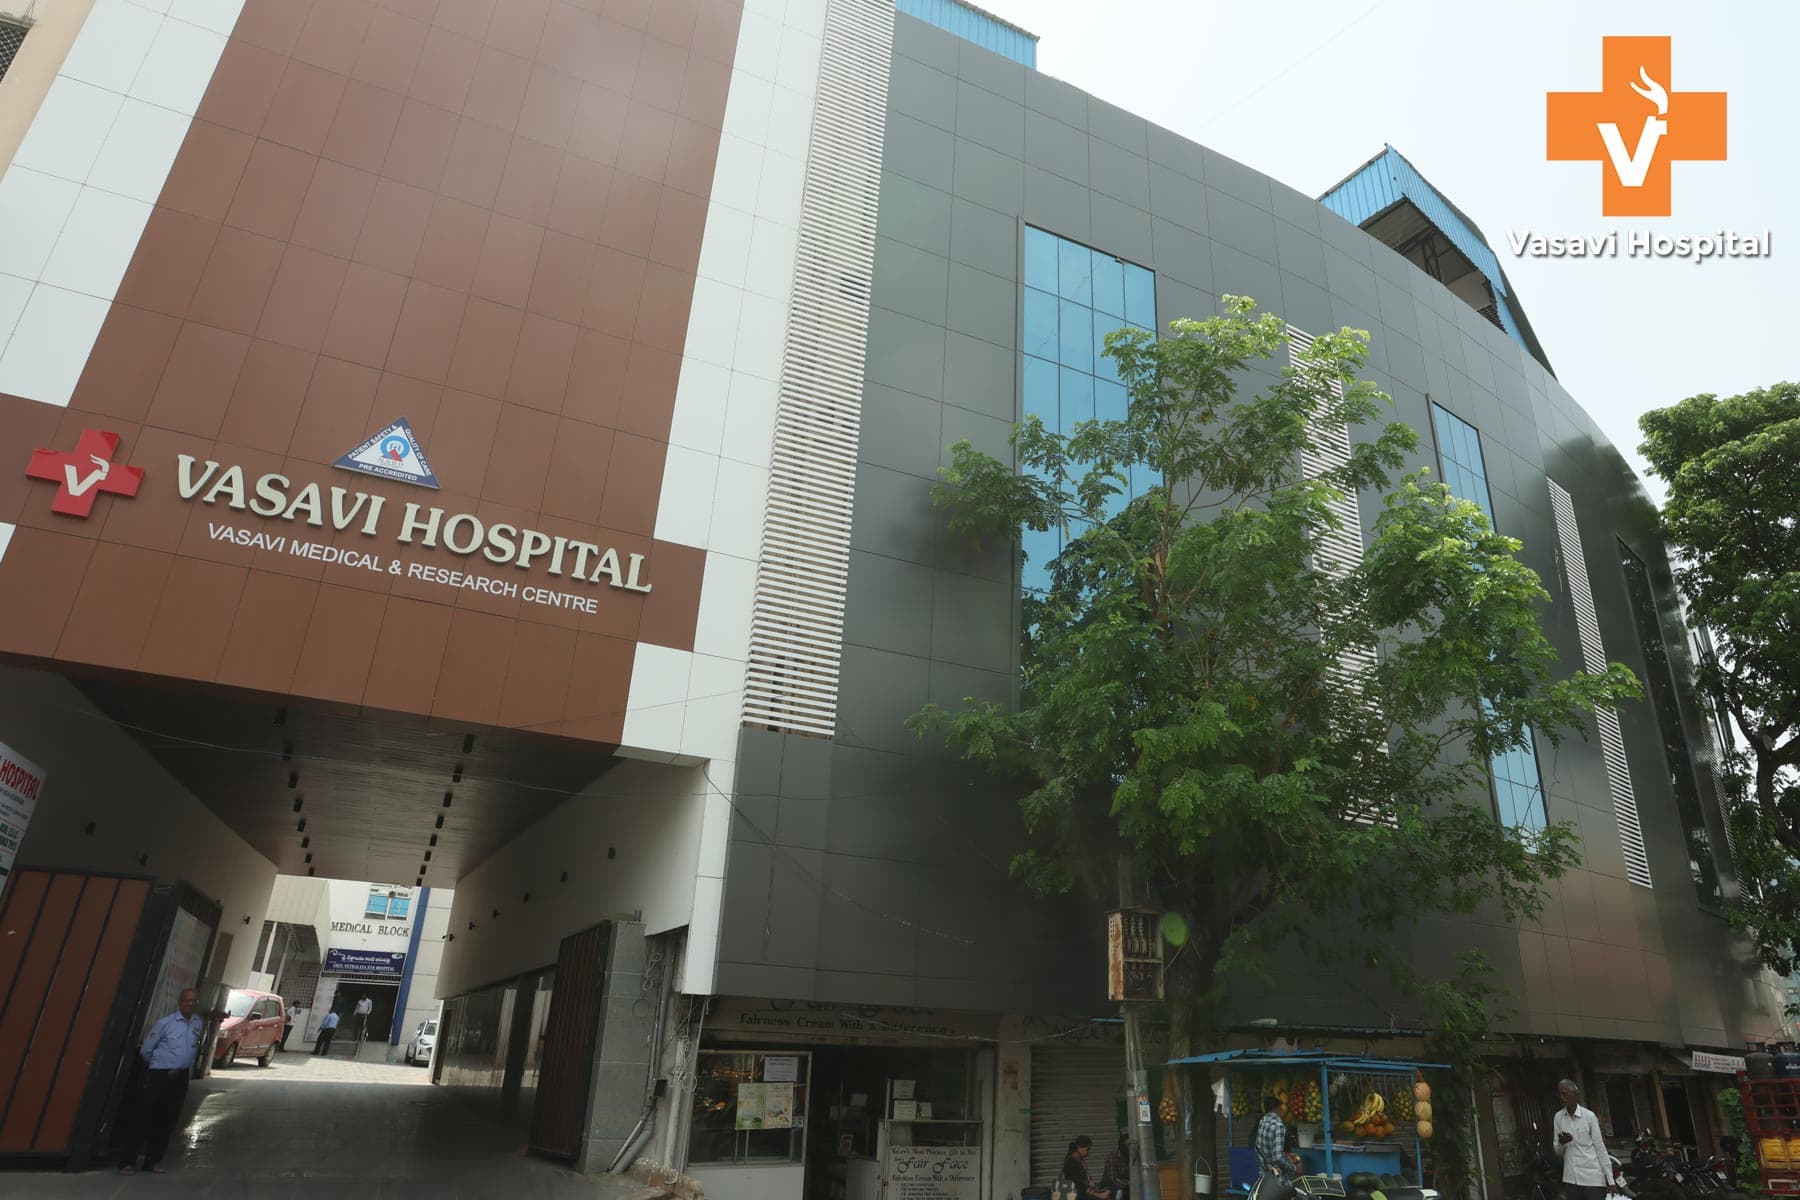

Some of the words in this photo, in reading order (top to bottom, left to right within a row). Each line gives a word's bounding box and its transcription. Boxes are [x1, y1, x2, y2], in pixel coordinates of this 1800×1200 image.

[347, 441, 372, 460] PATIENT
[370, 427, 394, 445] SAFETY
[404, 428, 420, 452] QUALITY
[420, 460, 433, 477] CARE
[358, 463, 374, 472] PRE
[373, 465, 418, 481] ACCREDITED
[177, 454, 386, 536] VASAVI
[397, 502, 653, 593] HOSPITAL
[207, 522, 287, 554] VASAVI
[289, 539, 384, 573] MEDICAL
[388, 558, 402, 576] &
[407, 563, 518, 599] RESEARCH
[522, 586, 599, 614] CENTRE
[0, 758, 41, 801] HOSPITAL
[330, 921, 373, 934] MEDICAL
[377, 925, 411, 937] BLOCK
[738, 1012, 791, 1026] Fairness
[796, 1016, 835, 1030] Cream
[839, 1018, 863, 1031] With
[897, 1156, 929, 1174] Fair
[932, 1157, 969, 1175] Face
